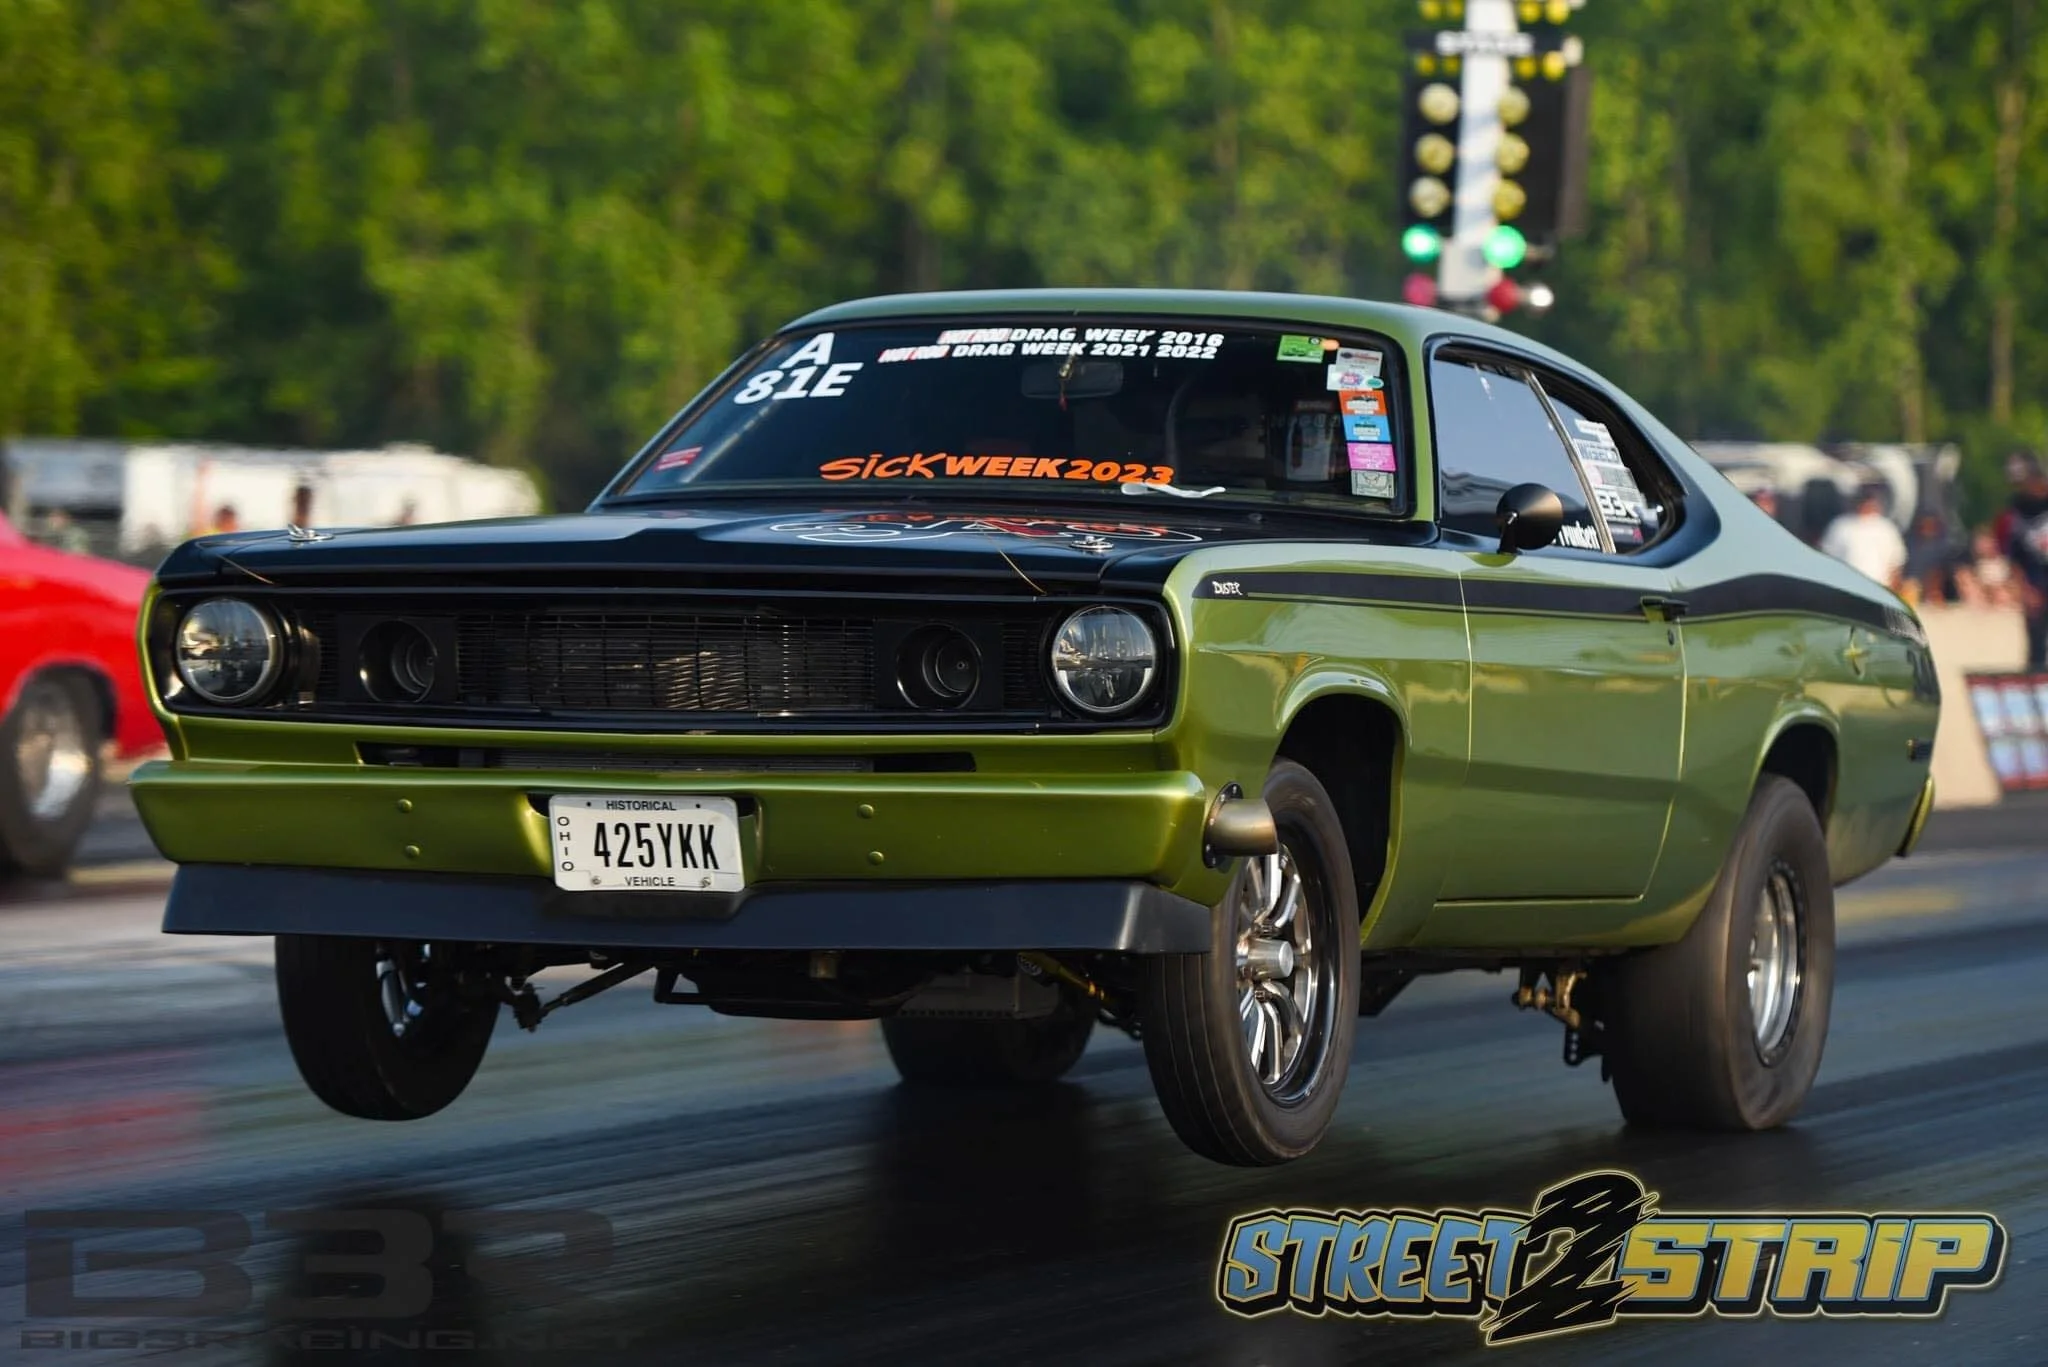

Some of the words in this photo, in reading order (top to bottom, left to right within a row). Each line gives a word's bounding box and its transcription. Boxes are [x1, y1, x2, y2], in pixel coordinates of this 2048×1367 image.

[1009, 328, 1076, 341] DRAG
[778, 332, 835, 369] A
[952, 343, 1016, 357] DRAG
[1021, 342, 1087, 356] WEEK
[1090, 343, 1150, 357] 2021
[1155, 344, 1218, 359] 2022
[734, 362, 864, 404] 81E
[606, 800, 677, 811] HISTORICAL
[557, 816, 574, 872] OHIO
[594, 822, 719, 869] 425YKK
[624, 876, 676, 886] VEHICLE
